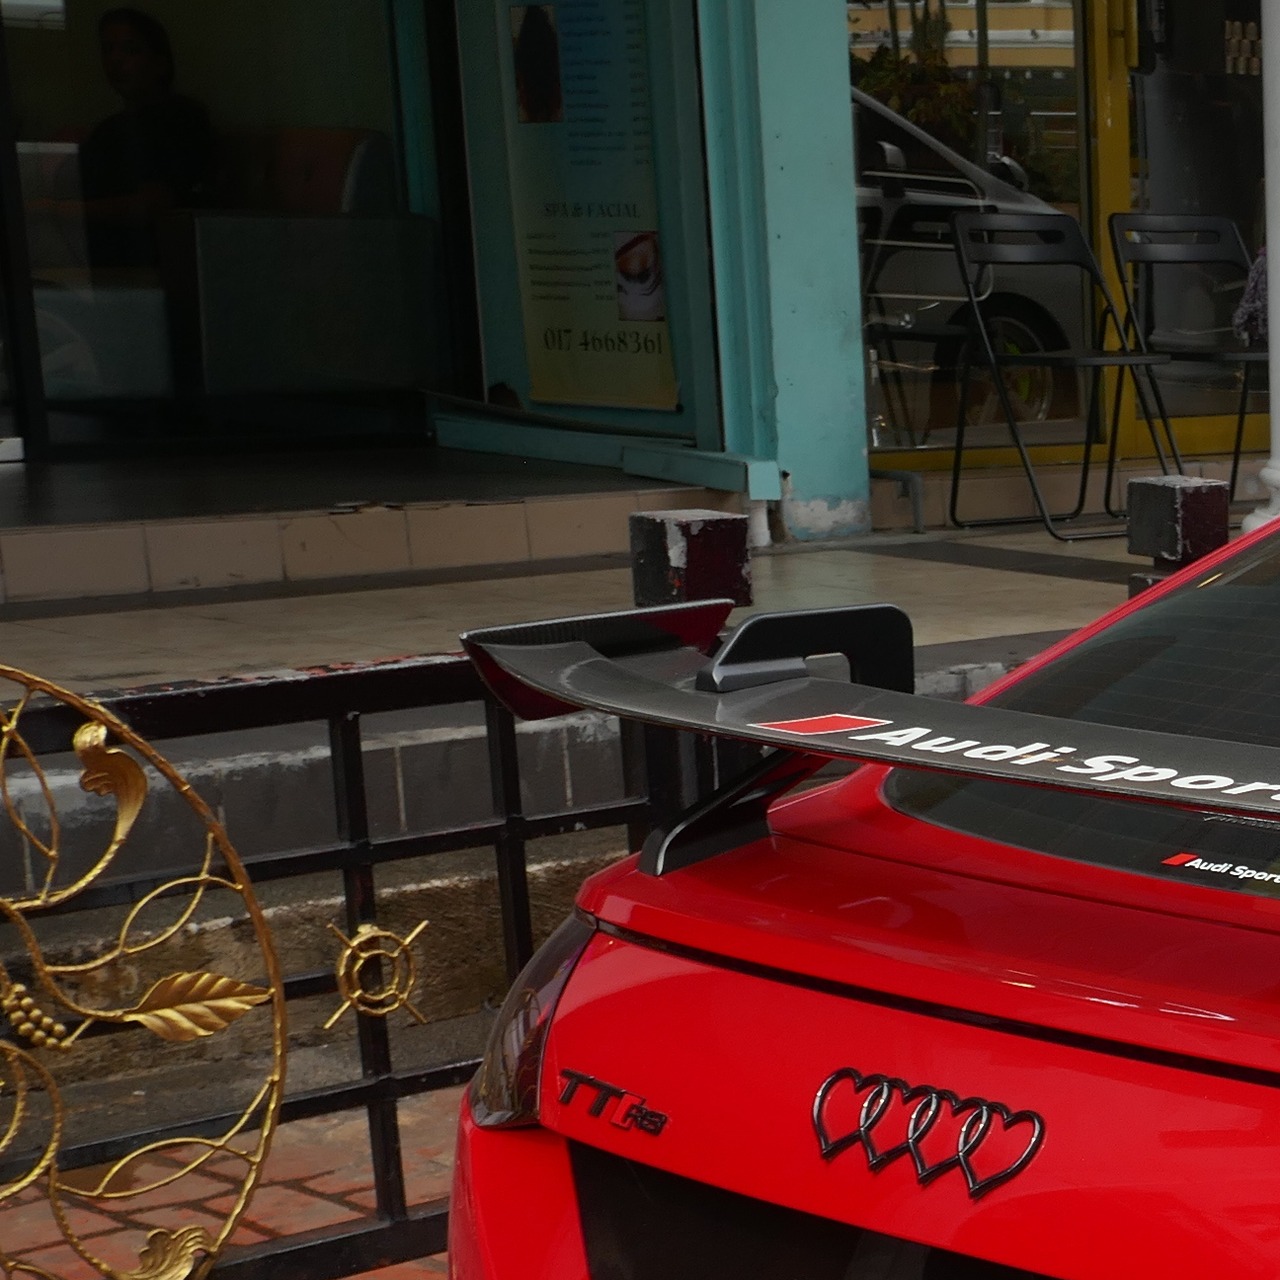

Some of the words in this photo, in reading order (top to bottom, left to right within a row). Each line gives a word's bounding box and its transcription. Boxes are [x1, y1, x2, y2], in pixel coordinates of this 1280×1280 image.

[543, 327, 572, 352] 017
[578, 329, 664, 356] 4668361
[849, 727, 1077, 766] Audi
[1184, 857, 1233, 874] Audi
[561, 1068, 626, 1118] TT
